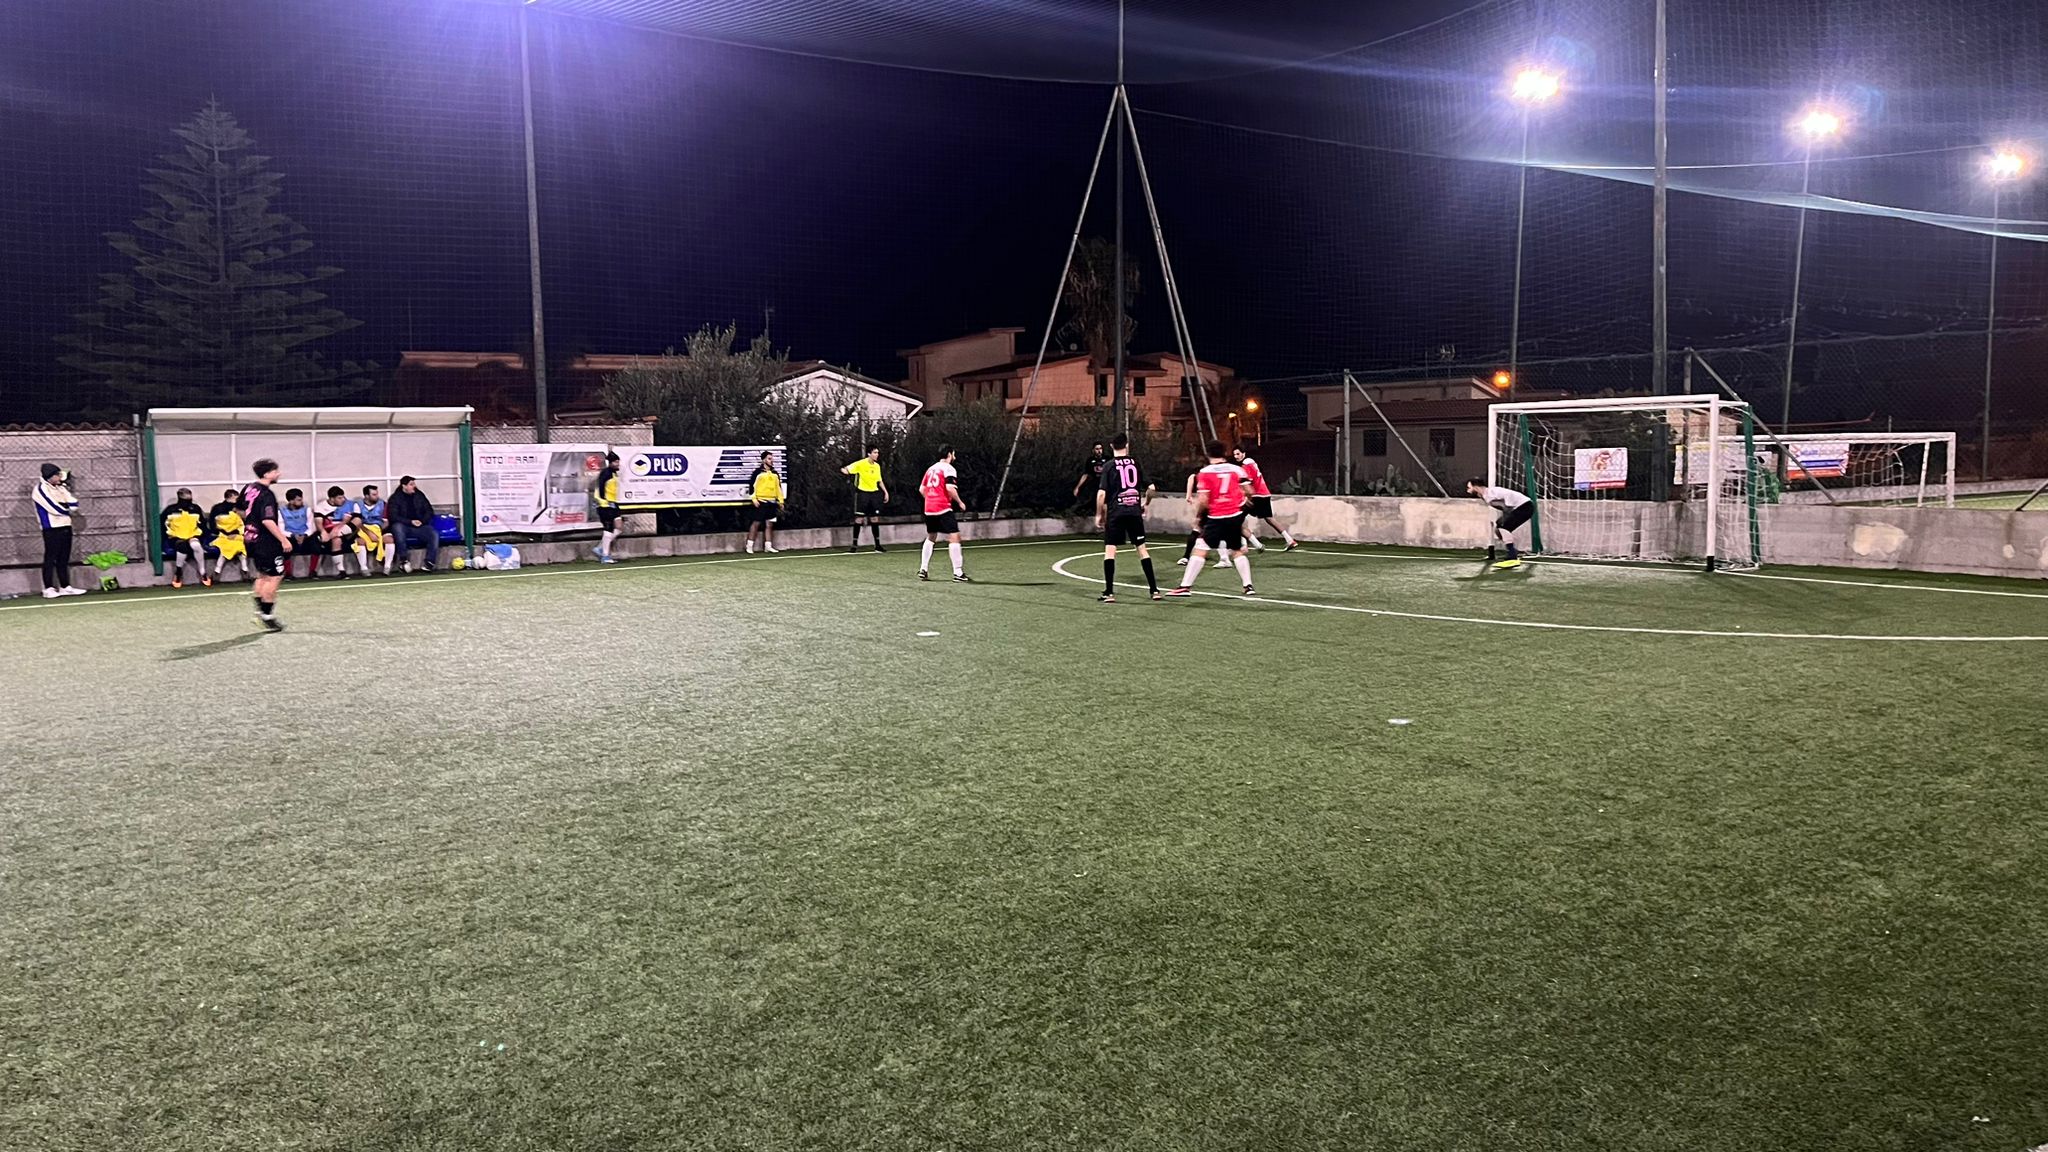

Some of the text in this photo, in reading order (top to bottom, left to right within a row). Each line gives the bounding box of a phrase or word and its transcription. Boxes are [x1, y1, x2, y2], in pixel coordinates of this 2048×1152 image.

[653, 457, 682, 472] PLUS
[926, 470, 940, 488] 25
[1115, 464, 1138, 489] 10
[1216, 474, 1231, 494] 7
